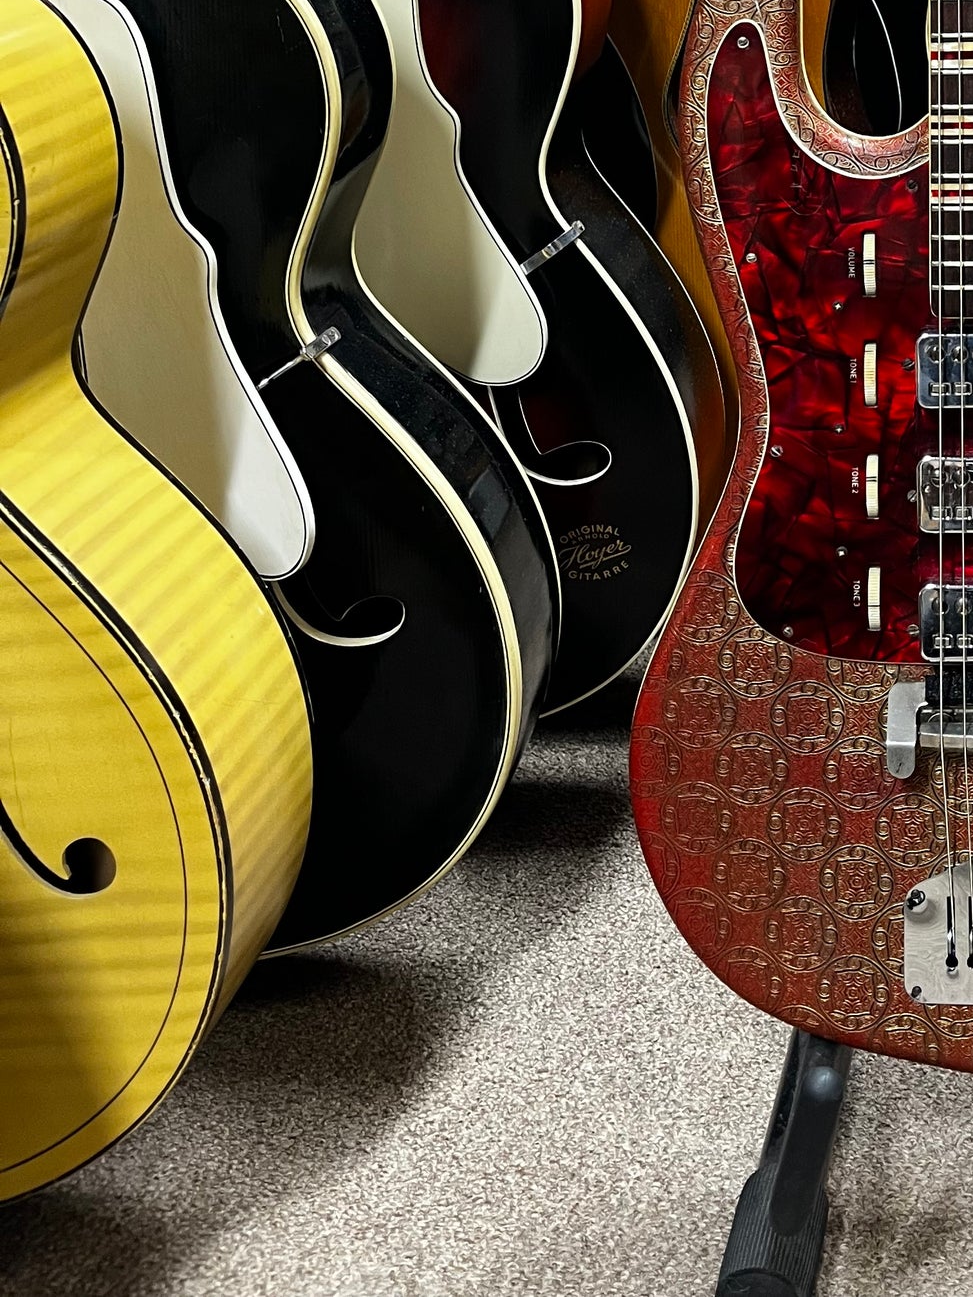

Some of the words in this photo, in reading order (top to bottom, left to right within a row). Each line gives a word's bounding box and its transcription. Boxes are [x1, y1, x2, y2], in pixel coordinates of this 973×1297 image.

[848, 247, 856, 279] VOLUME
[850, 358, 858, 379] TONE
[851, 466, 859, 488] TONE
[560, 524, 620, 544] ORIGINAL
[559, 539, 632, 571] Hoyer
[568, 560, 630, 580] GITARRE
[853, 580, 861, 601] TONE
